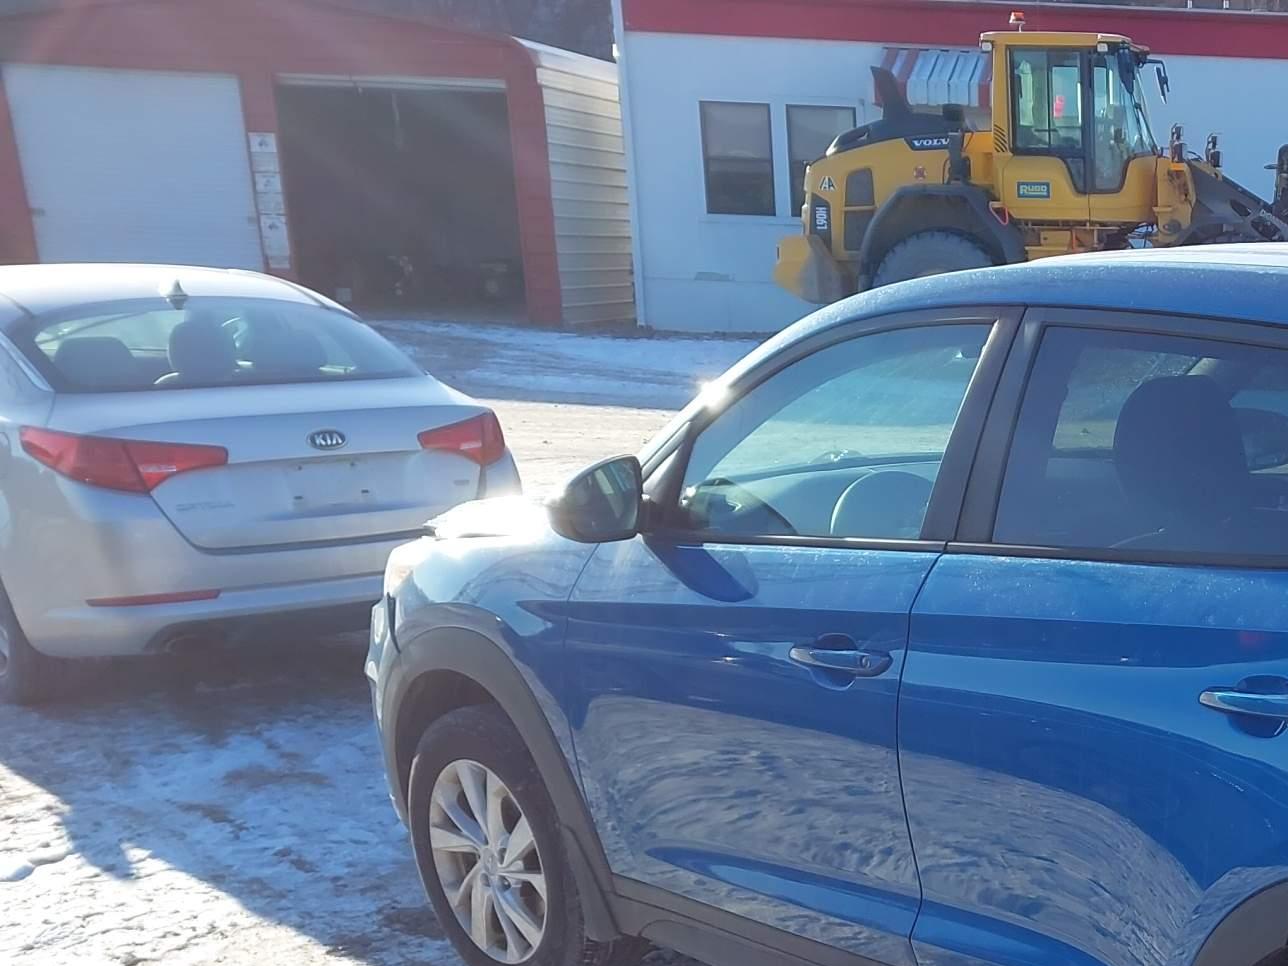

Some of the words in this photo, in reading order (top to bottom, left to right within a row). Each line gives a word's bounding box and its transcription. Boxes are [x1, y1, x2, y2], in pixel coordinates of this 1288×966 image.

[912, 137, 950, 147] VOLV
[815, 206, 828, 230] L90H
[313, 432, 343, 446] KIA
